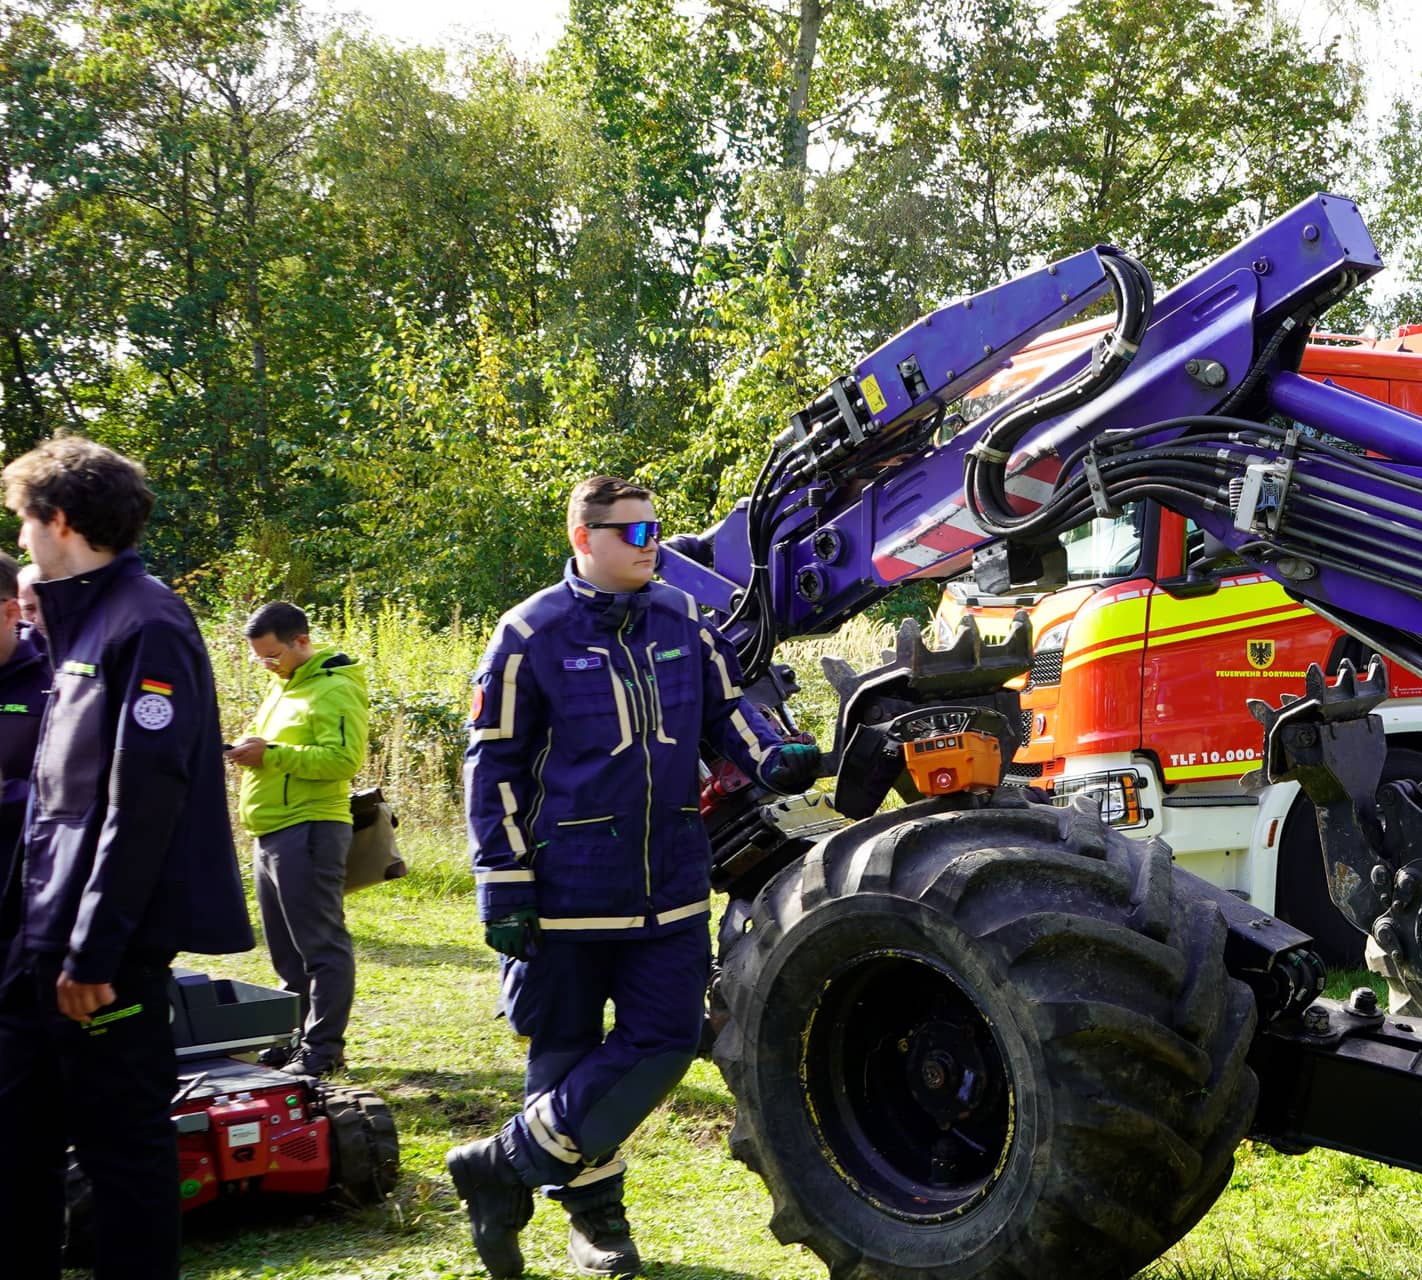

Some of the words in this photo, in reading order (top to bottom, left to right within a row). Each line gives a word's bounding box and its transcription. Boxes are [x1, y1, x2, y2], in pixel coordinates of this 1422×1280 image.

[1215, 670, 1260, 678] FEUERWEHR
[1262, 670, 1307, 678] DORTMUND
[1170, 752, 1197, 767] TLF
[1201, 748, 1264, 763] 10.000-
